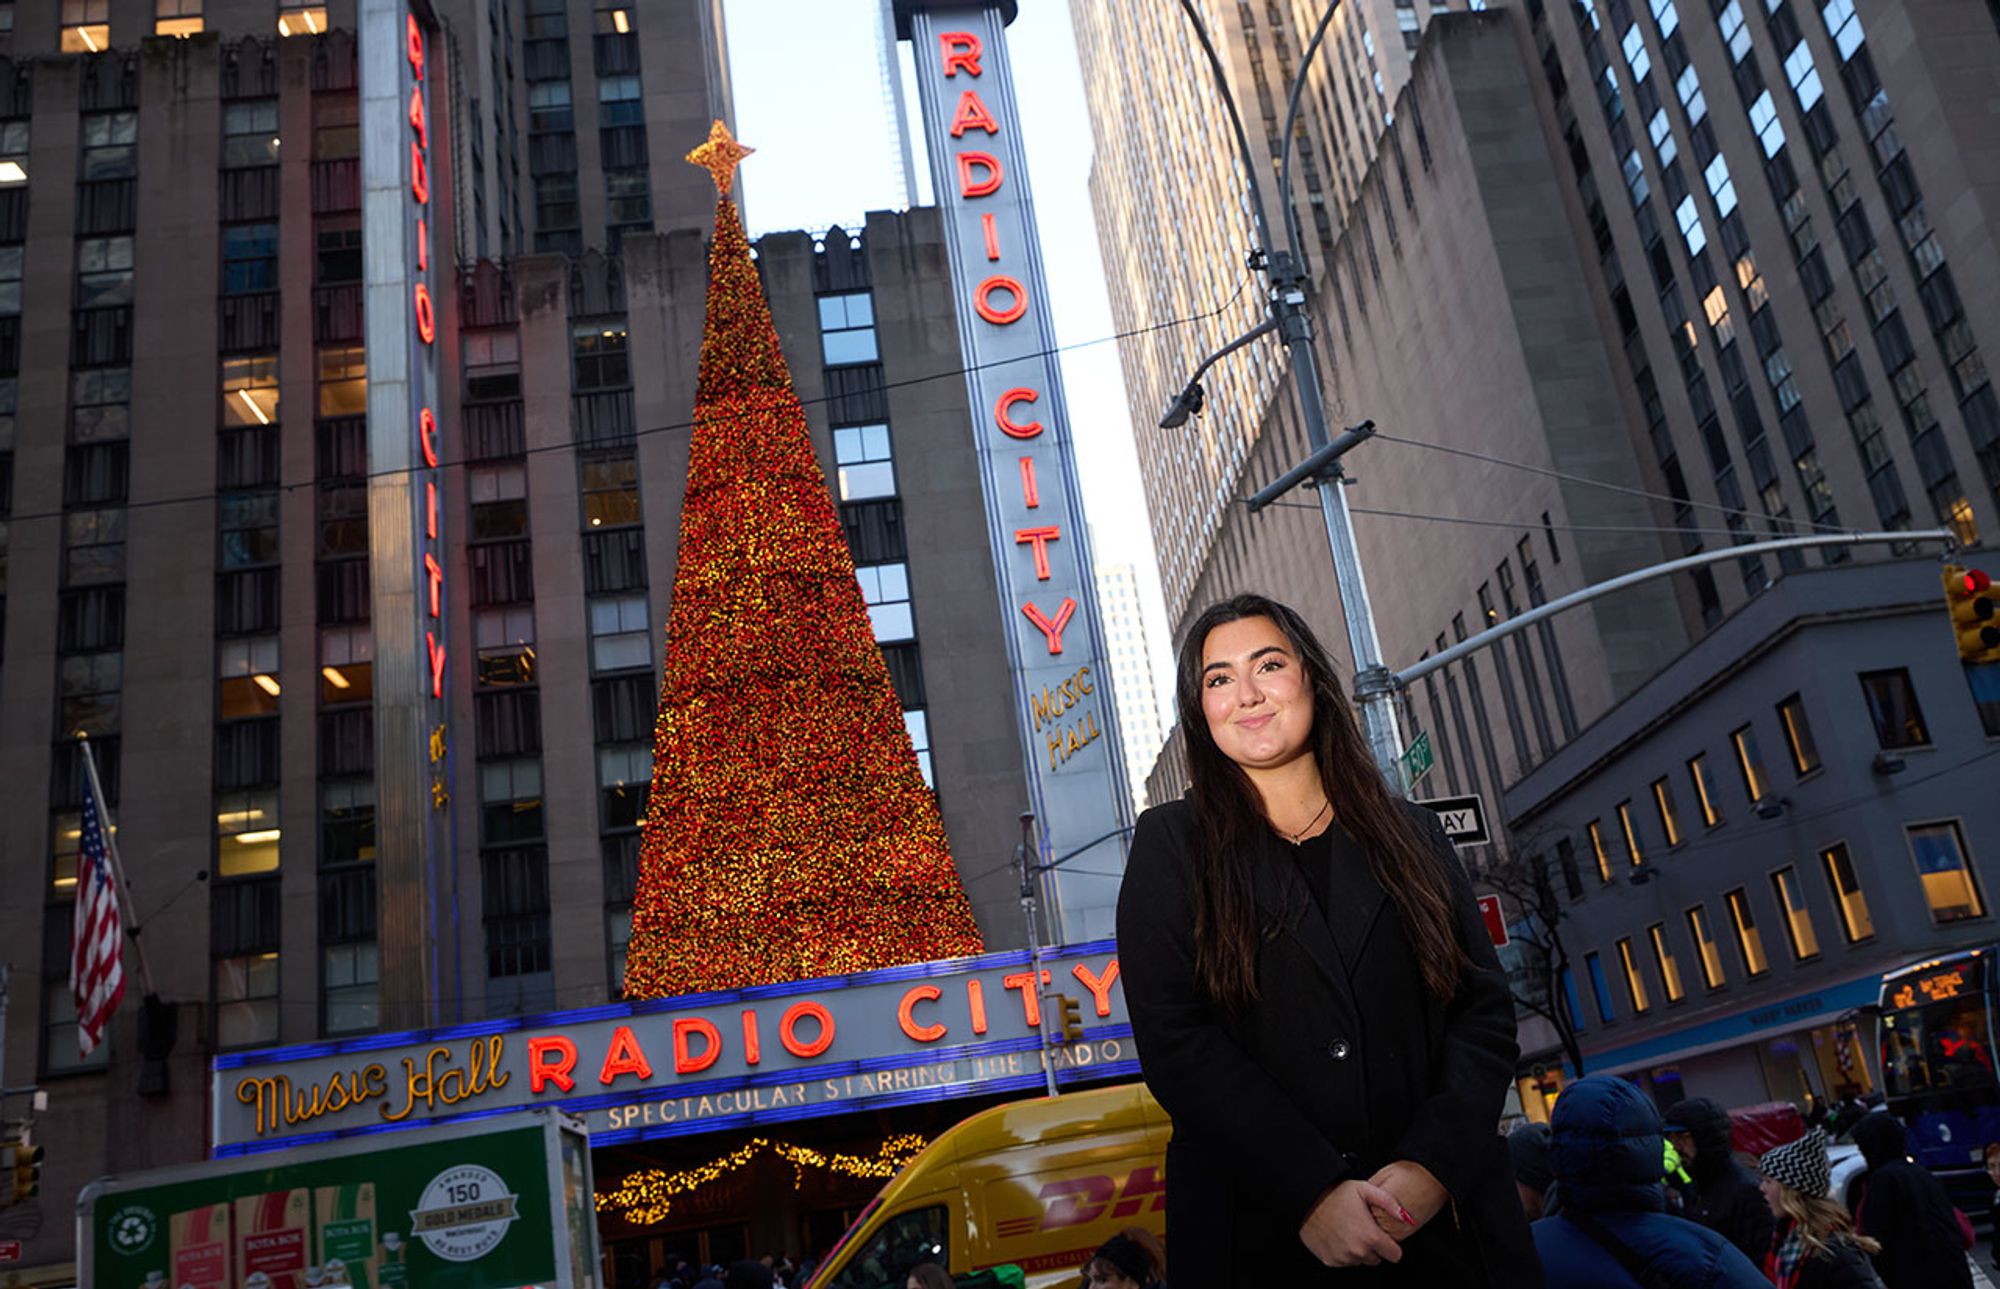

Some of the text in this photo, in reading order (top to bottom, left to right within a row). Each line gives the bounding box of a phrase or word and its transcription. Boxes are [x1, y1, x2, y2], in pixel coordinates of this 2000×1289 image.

[407, 13, 435, 344] RADIO
[938, 31, 1077, 654] RADIO CITY
[418, 407, 446, 698] CITY
[1030, 666, 1094, 733] MUSIC
[1046, 711, 1100, 771] HALL
[1444, 812, 1466, 831] AY
[236, 959, 1121, 1136] Music Hall RADIO CITY
[607, 1083, 806, 1129] SPECTACULAR
[825, 1062, 955, 1100] STARRING
[424, 1203, 504, 1227] GOLD MEDALS
[447, 1182, 481, 1204] 150
[1040, 1166, 1166, 1231] DH
